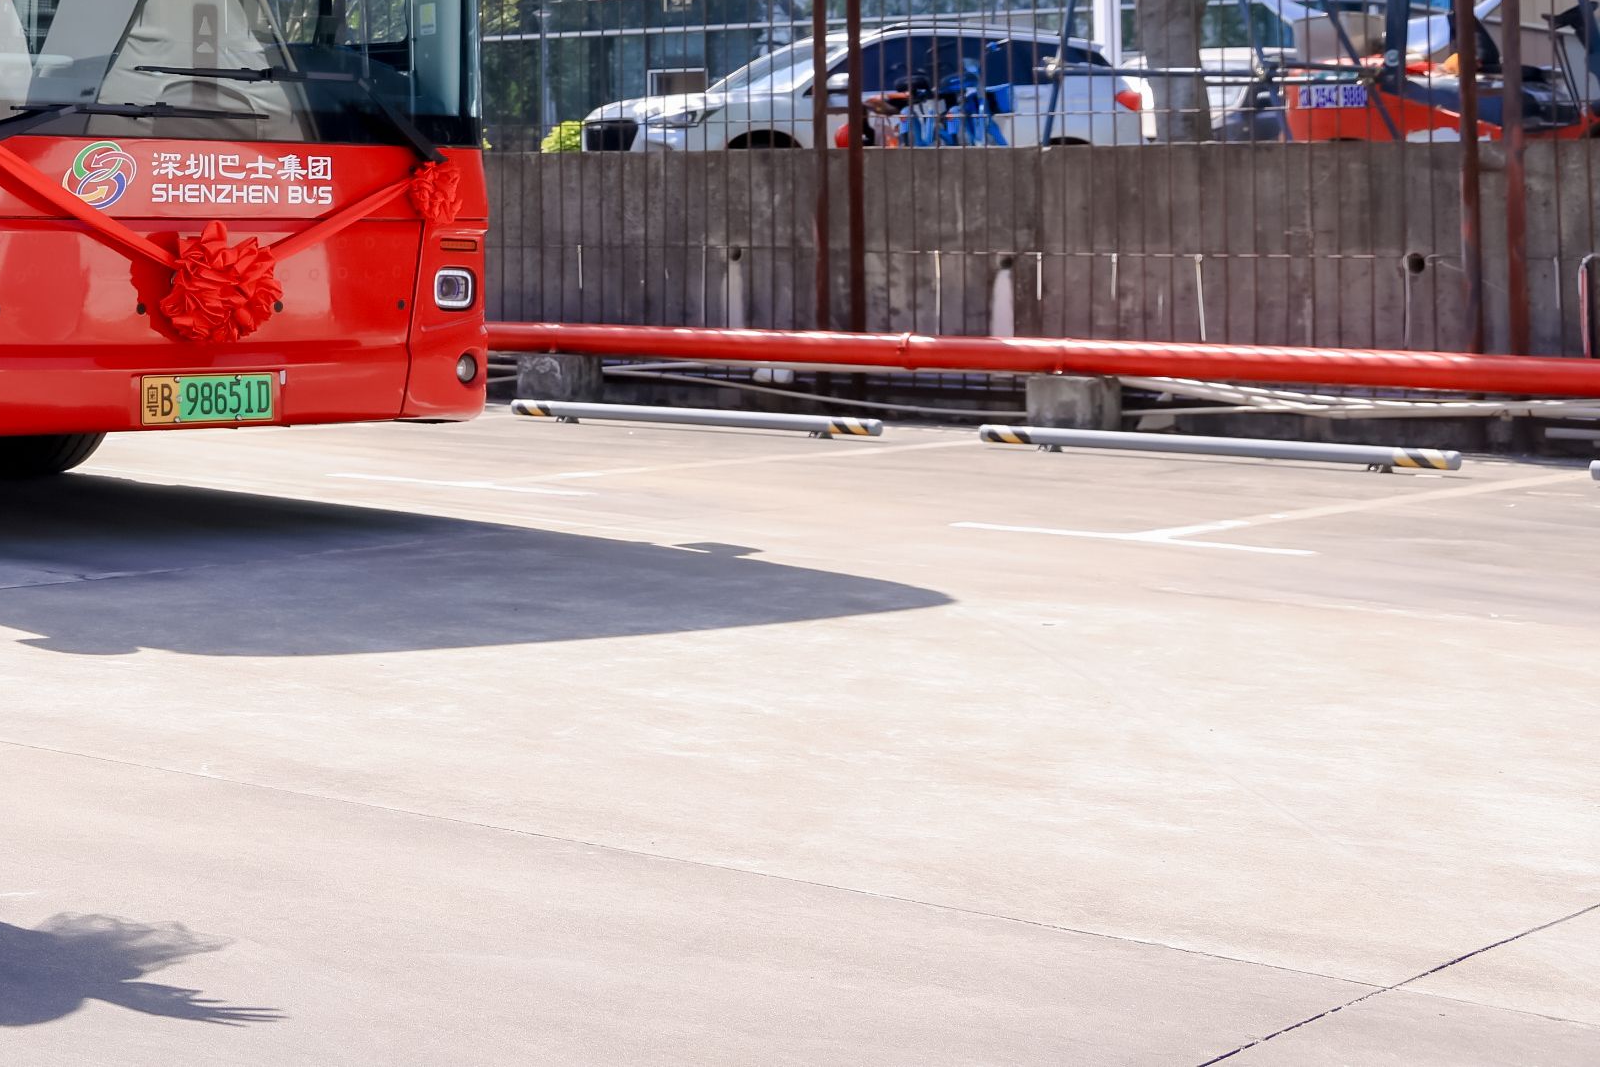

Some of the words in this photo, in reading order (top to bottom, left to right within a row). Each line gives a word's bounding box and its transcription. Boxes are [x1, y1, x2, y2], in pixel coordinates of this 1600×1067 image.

[151, 152, 332, 181] 深圳巴士集团
[151, 184, 279, 204] SHENZHEN
[287, 185, 333, 205] BUS
